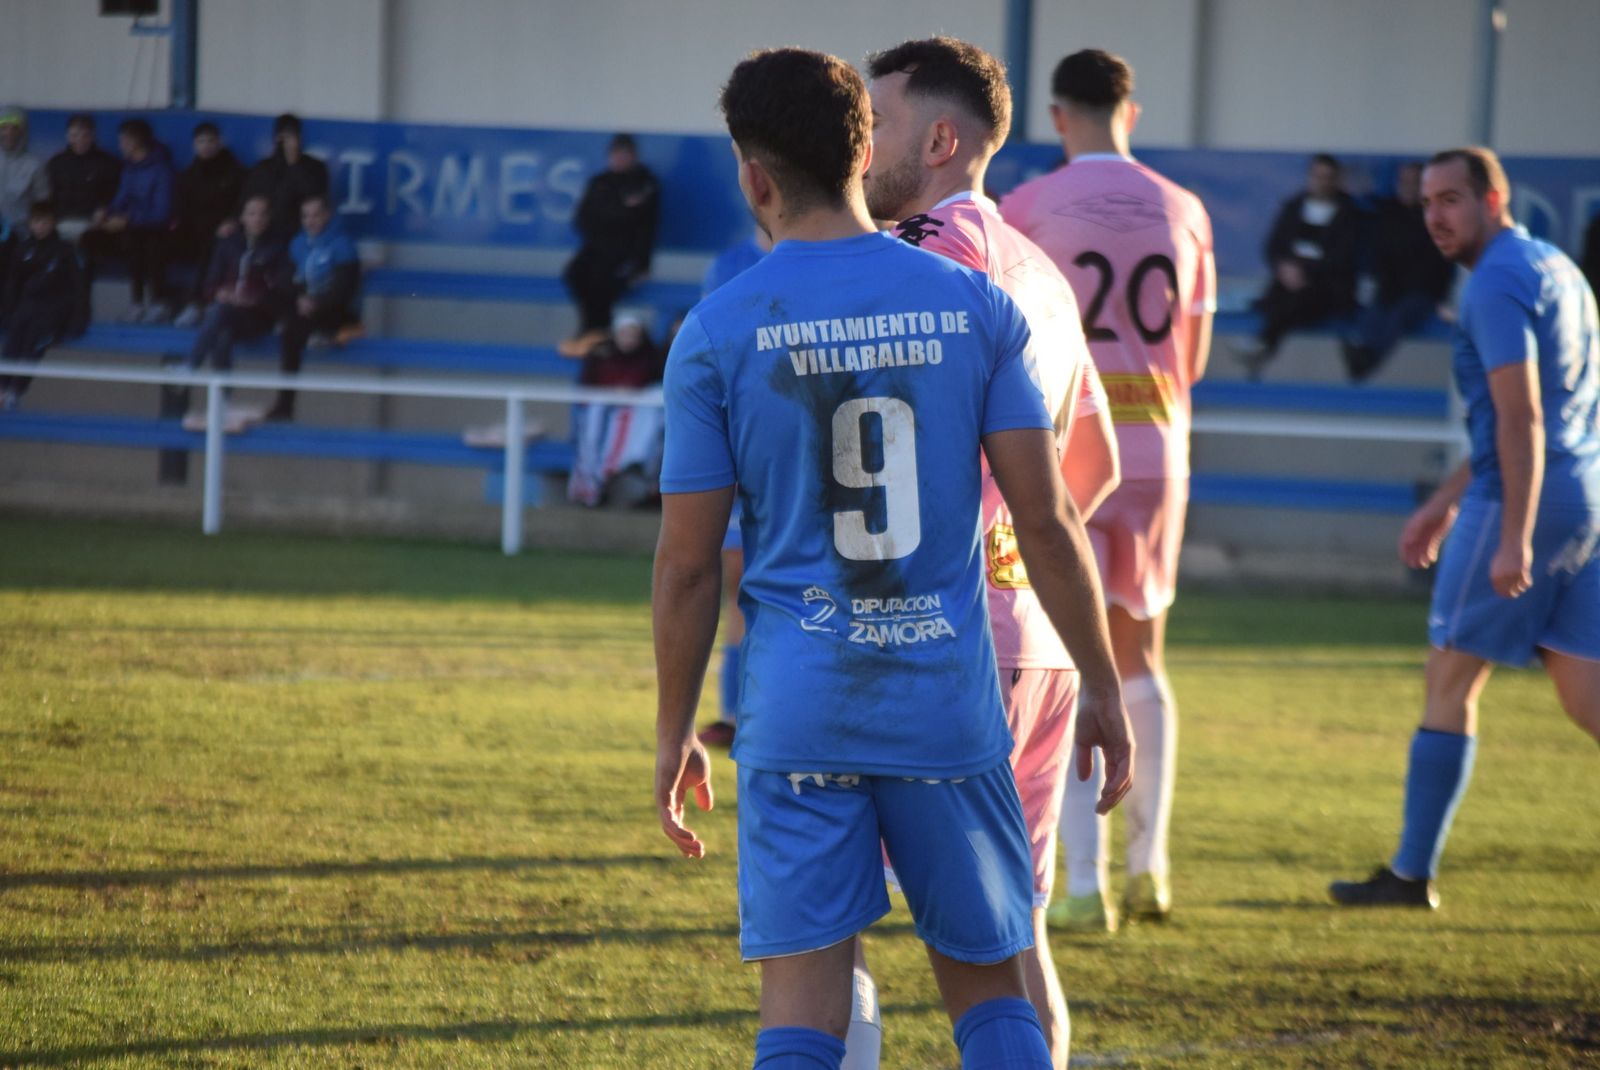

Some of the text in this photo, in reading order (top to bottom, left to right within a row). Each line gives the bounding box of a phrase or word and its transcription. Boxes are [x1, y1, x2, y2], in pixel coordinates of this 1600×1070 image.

[304, 146, 584, 225] IRMES
[1072, 251, 1179, 346] 20
[756, 311, 971, 352] AYUNTAMIENTO DE
[789, 339, 943, 376] VILLARALBO
[831, 396, 921, 561] 9
[847, 617, 957, 648] ZAMORA
